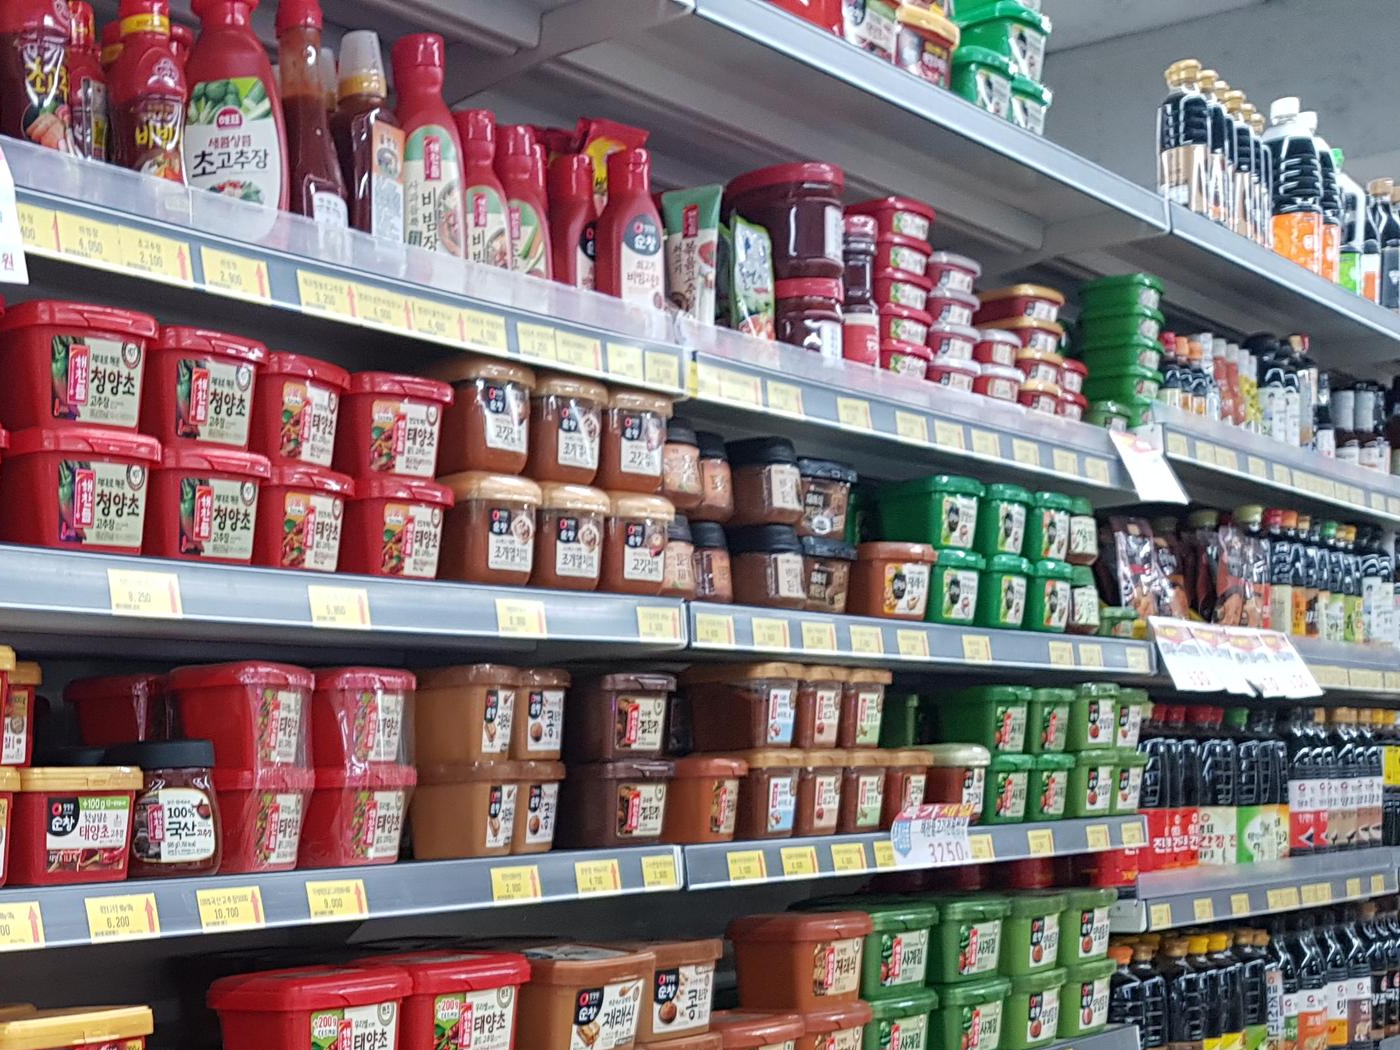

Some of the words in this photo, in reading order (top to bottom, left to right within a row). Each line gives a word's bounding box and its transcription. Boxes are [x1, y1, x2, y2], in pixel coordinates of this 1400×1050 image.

[192, 150, 270, 178] 초고추장
[90, 367, 136, 396] 청양초
[209, 389, 246, 418] 청양초
[96, 492, 140, 518] 청양초
[213, 506, 251, 531] 청양초
[167, 807, 195, 819] 100%
[51, 817, 75, 831] 순창
[79, 826, 110, 840] 태양초
[167, 821, 196, 837] 국산
[474, 1010, 507, 1035] 태양초
[601, 997, 639, 1030] 재래식
